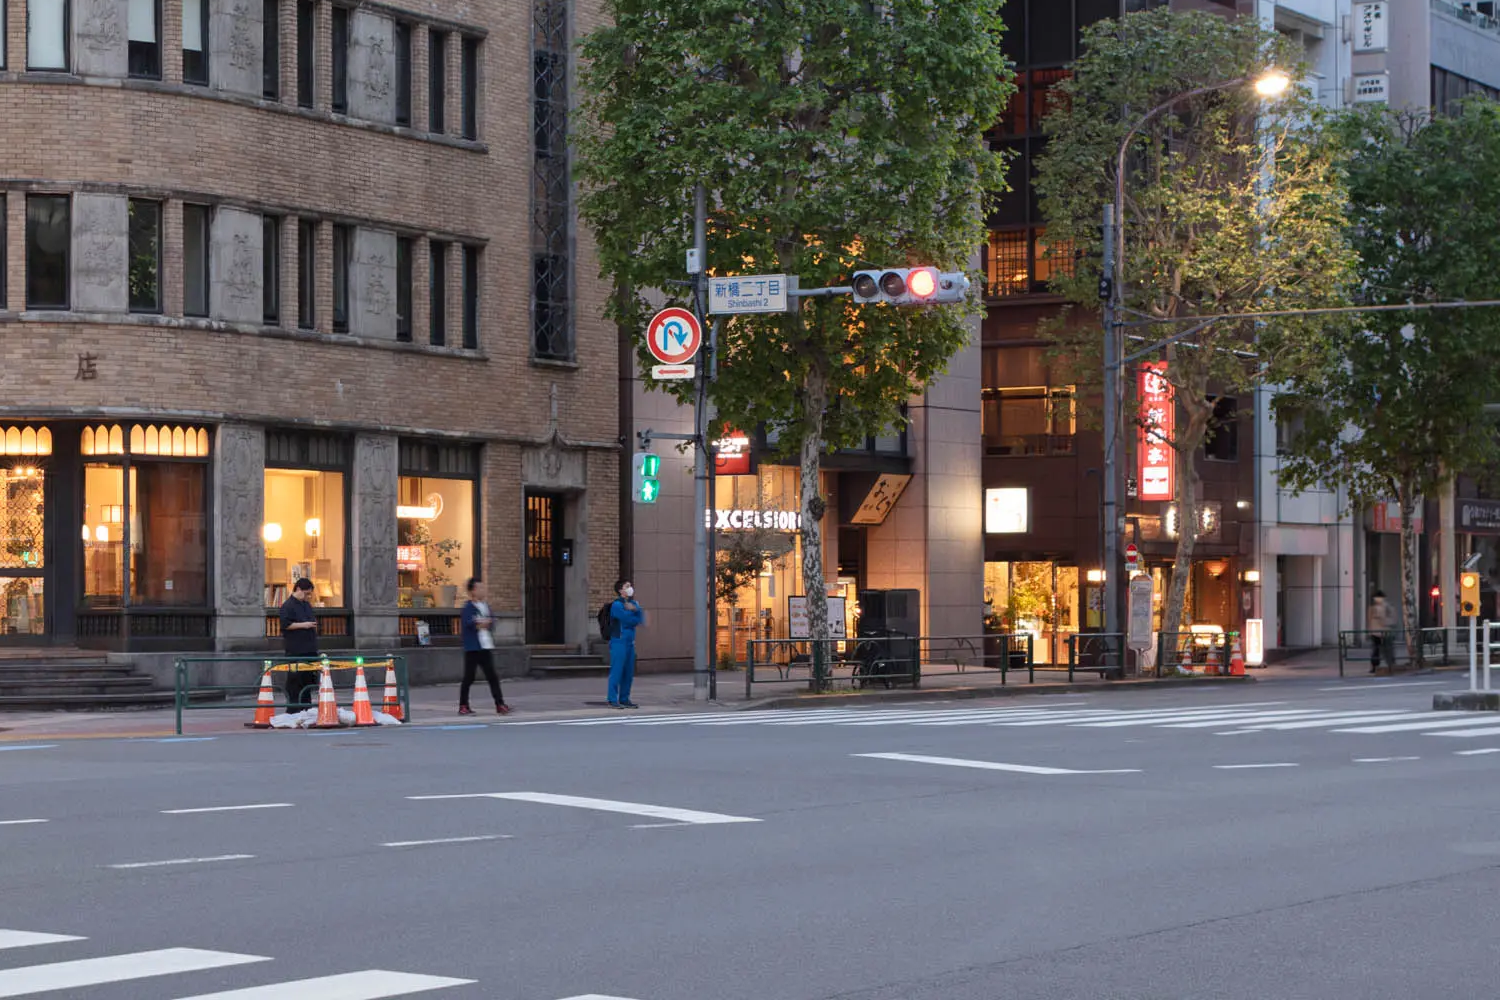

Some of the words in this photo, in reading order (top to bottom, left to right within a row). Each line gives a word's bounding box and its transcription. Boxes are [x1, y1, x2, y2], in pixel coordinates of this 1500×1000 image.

[715, 279, 780, 298] 新橋二丁目
[727, 298, 762, 309] Shinbashi
[763, 298, 769, 307] 2
